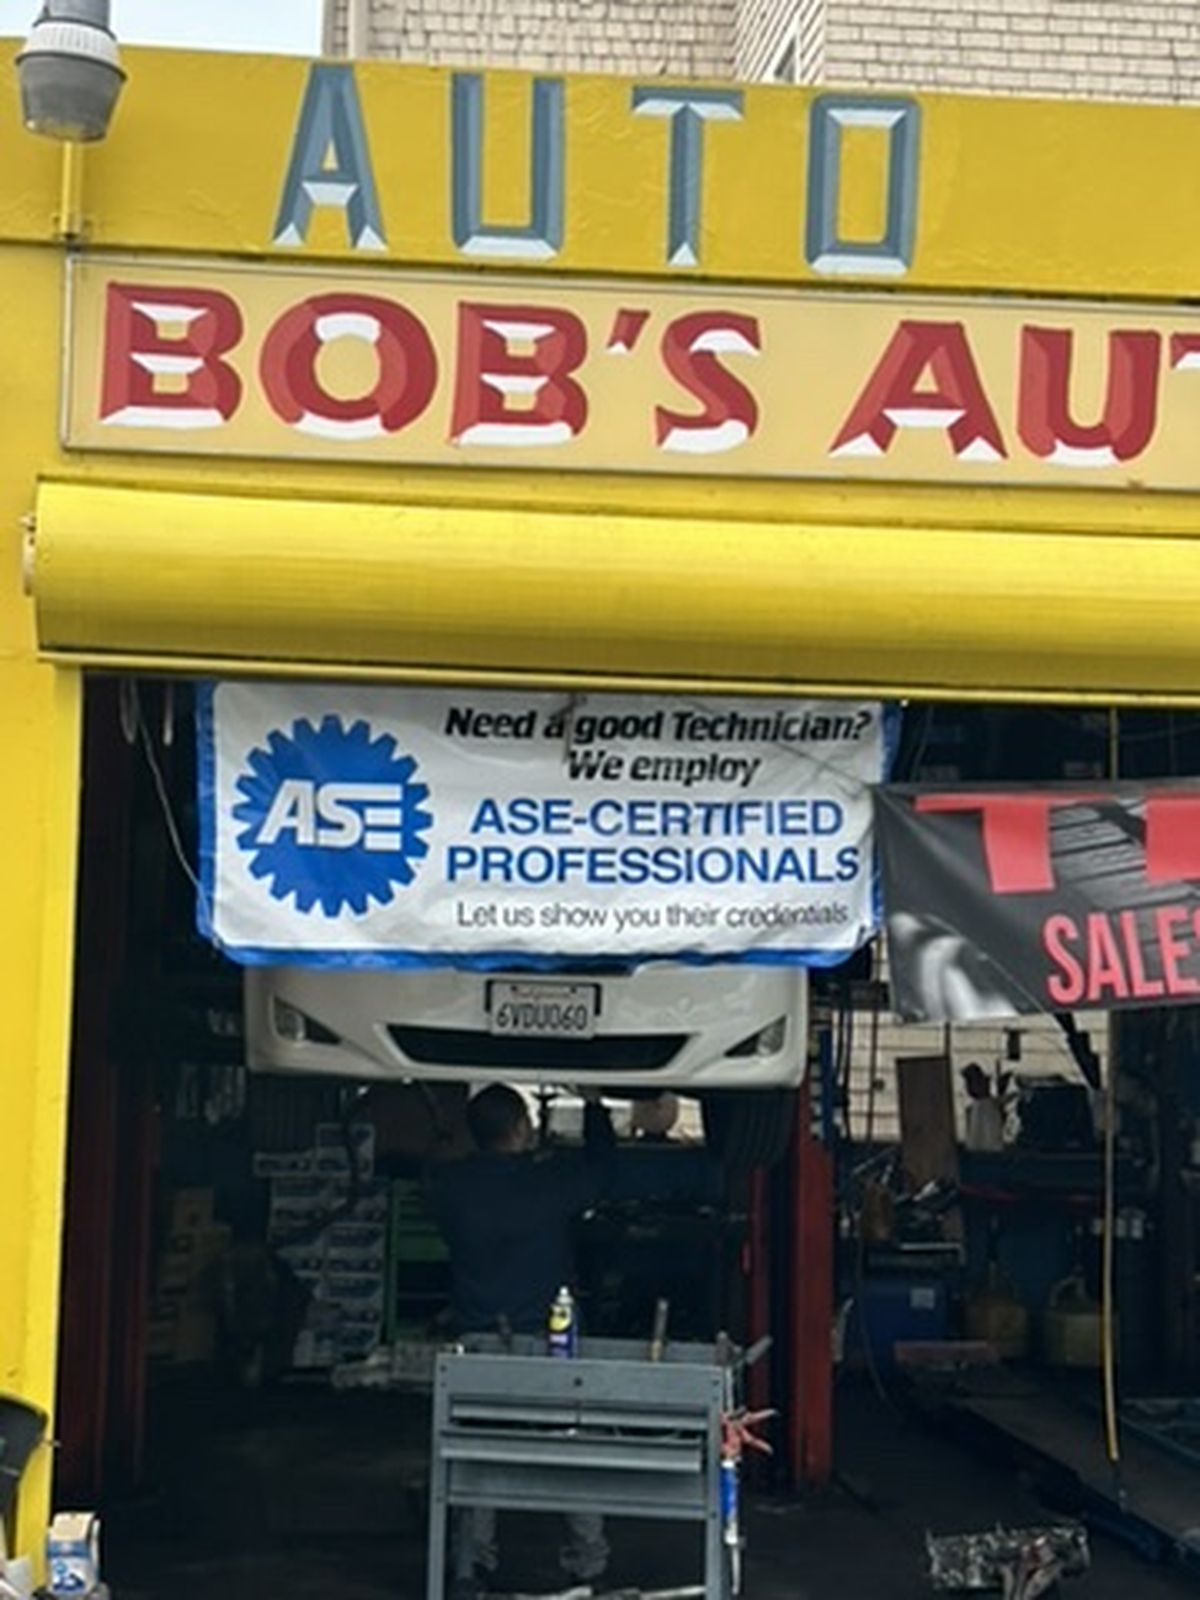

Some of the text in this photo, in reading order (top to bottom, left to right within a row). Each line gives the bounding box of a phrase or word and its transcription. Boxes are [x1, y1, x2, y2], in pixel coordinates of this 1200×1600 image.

[272, 63, 923, 277] AUTO
[99, 281, 1200, 468] BOB'S AU
[445, 707, 871, 743] Need a good Technician?
[568, 751, 761, 788] We employ
[255, 778, 402, 851] ASE
[470, 797, 844, 836] ASE-CERTIFIED
[446, 845, 859, 884] PROFESSIONALS
[457, 902, 848, 932] Let us show you their credentials
[1043, 903, 1200, 1005] SALE
